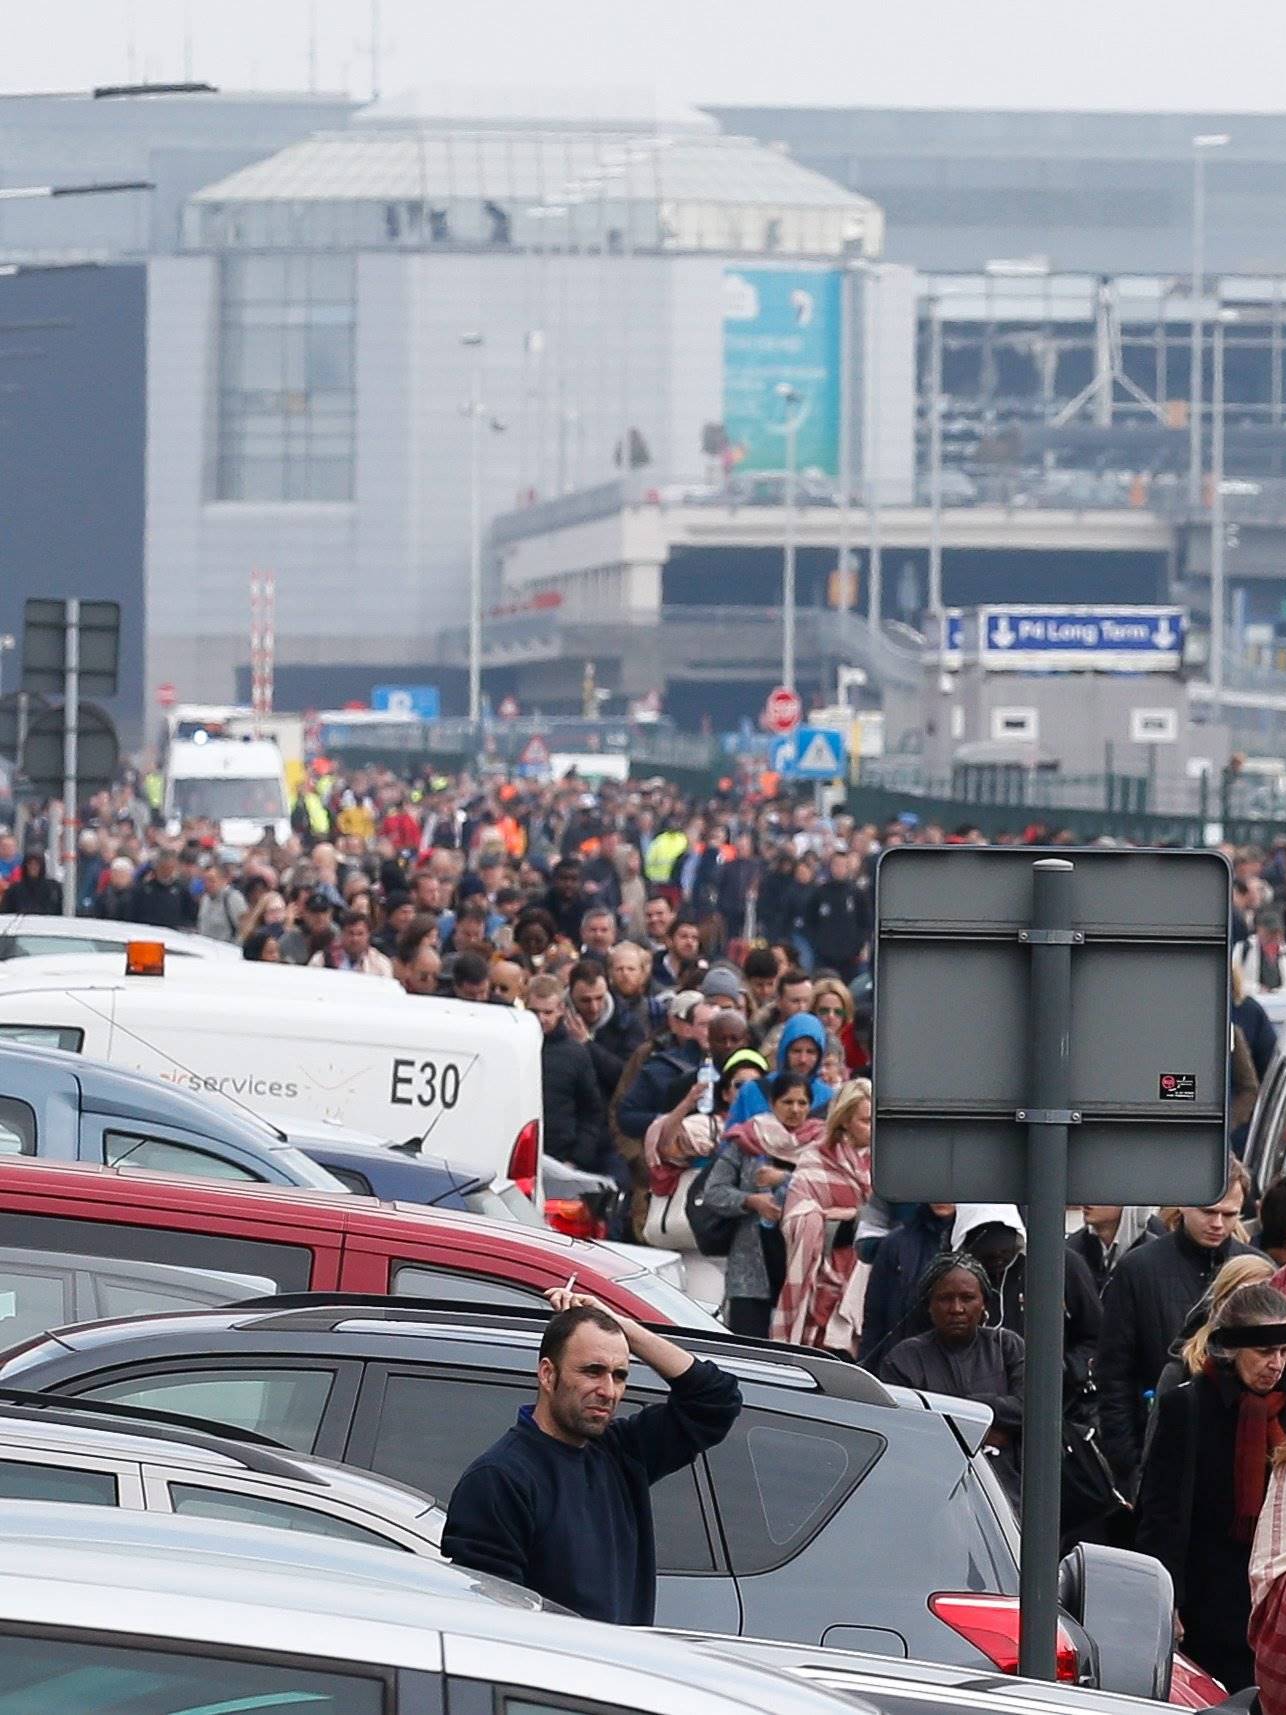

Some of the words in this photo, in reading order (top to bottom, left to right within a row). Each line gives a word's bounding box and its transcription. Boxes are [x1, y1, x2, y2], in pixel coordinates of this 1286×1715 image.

[1047, 620, 1099, 646] Long
[1100, 620, 1150, 641] Term
[391, 1058, 460, 1109] E30
